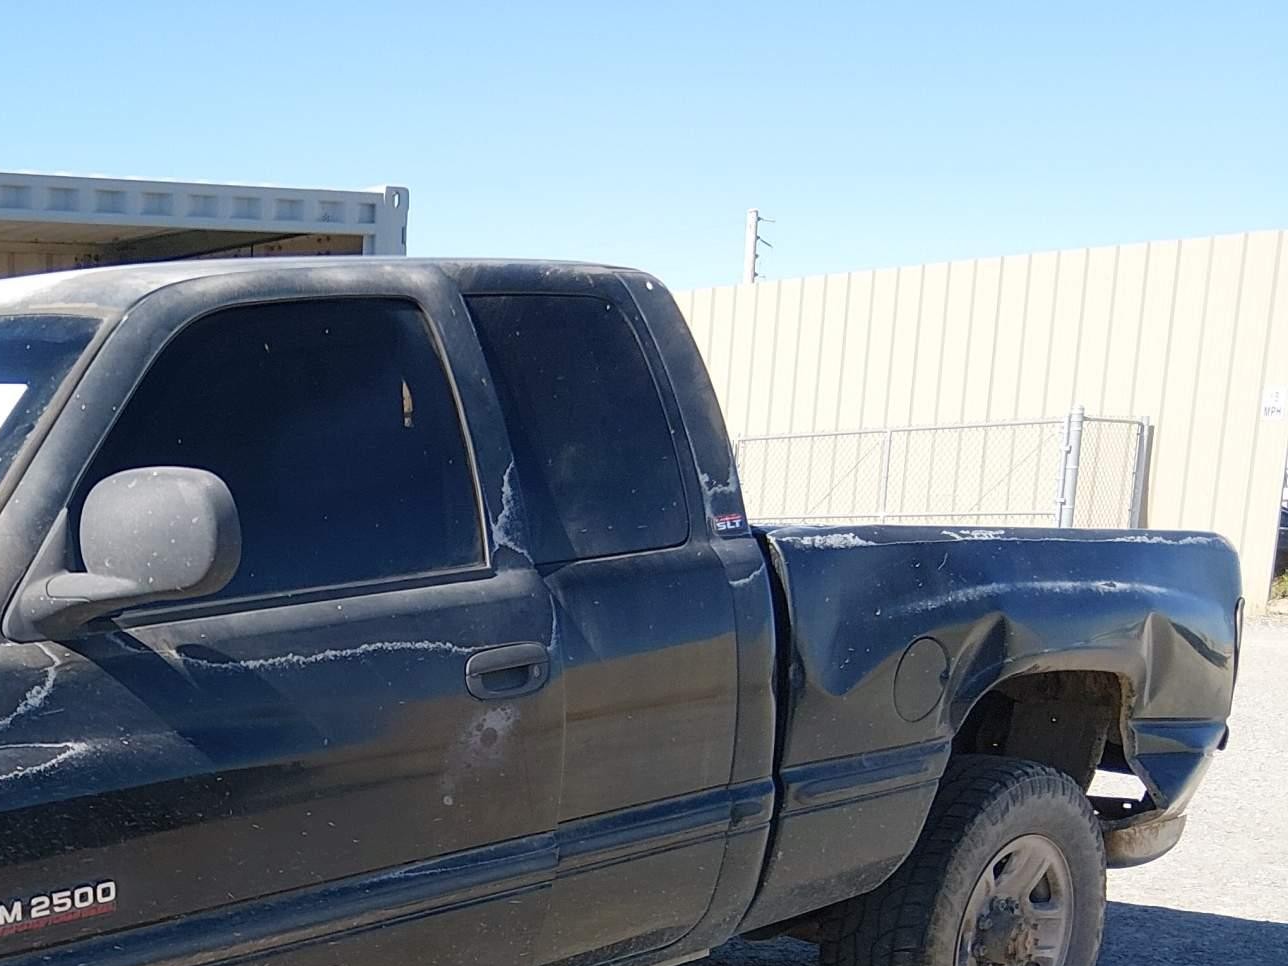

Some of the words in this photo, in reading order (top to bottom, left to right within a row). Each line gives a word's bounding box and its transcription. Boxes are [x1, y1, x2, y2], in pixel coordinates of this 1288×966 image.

[1263, 406, 1282, 417] MPH
[716, 519, 741, 531] SLT
[30, 881, 116, 919] 2500
